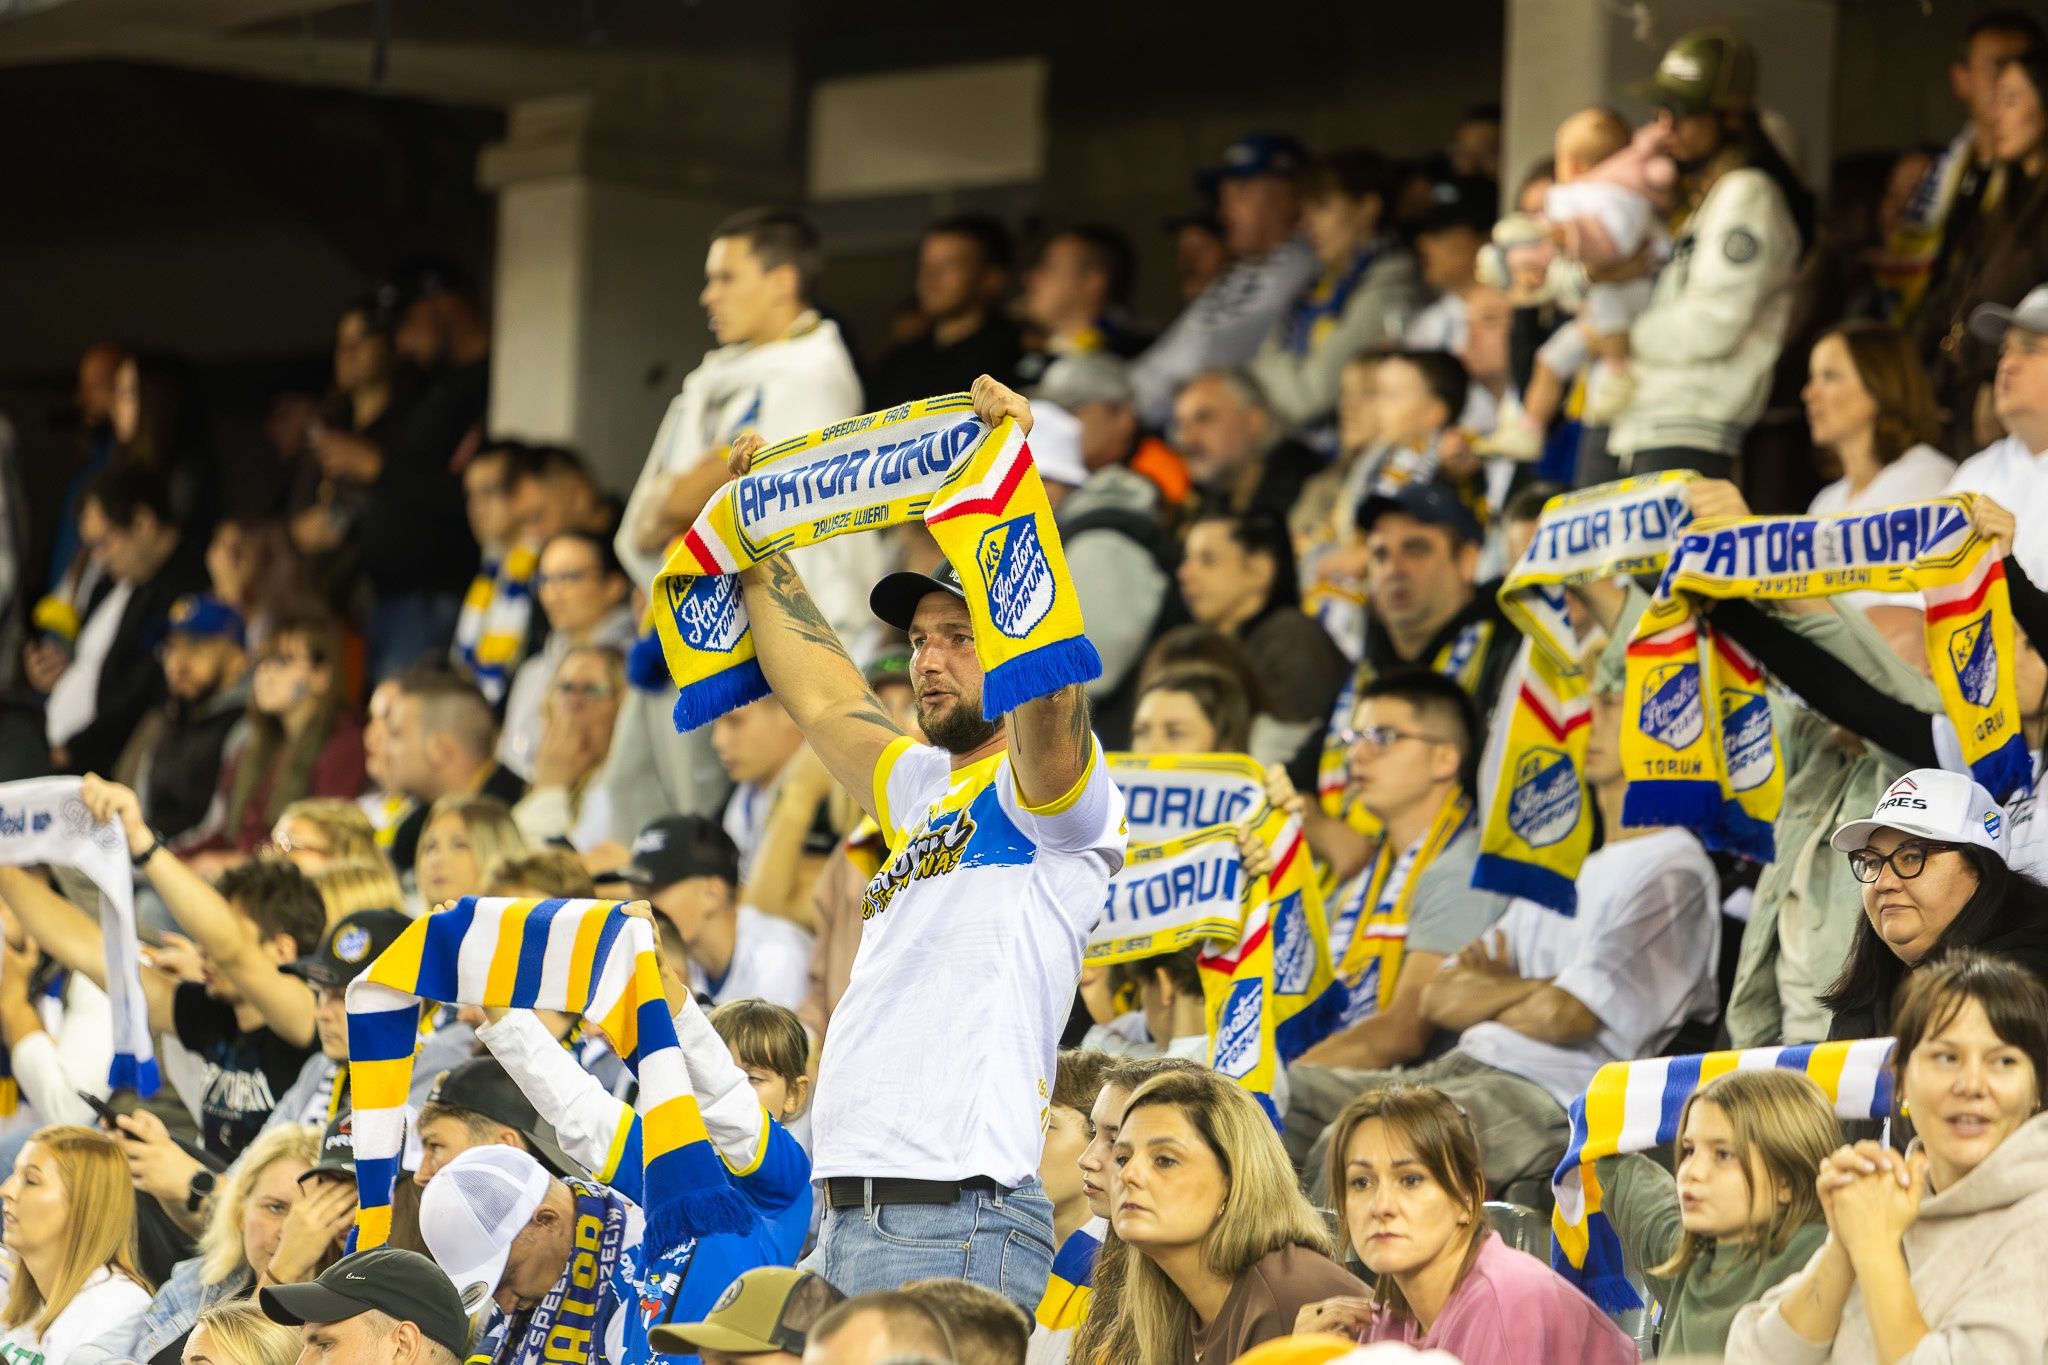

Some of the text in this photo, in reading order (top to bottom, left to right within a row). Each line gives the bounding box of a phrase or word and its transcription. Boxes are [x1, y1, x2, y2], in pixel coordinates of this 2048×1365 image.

[822, 404, 911, 441] SPEEDWAY FANS
[739, 450, 870, 527] APATOR
[813, 504, 889, 539] ZAWSZE WIERNI
[985, 540, 1001, 579] KS
[992, 523, 1035, 626] Apator
[1661, 520, 1818, 599] PATOR
[1876, 797, 1928, 815] PRES
[914, 847, 965, 881] NAS
[542, 1213, 604, 1365] ATOR
